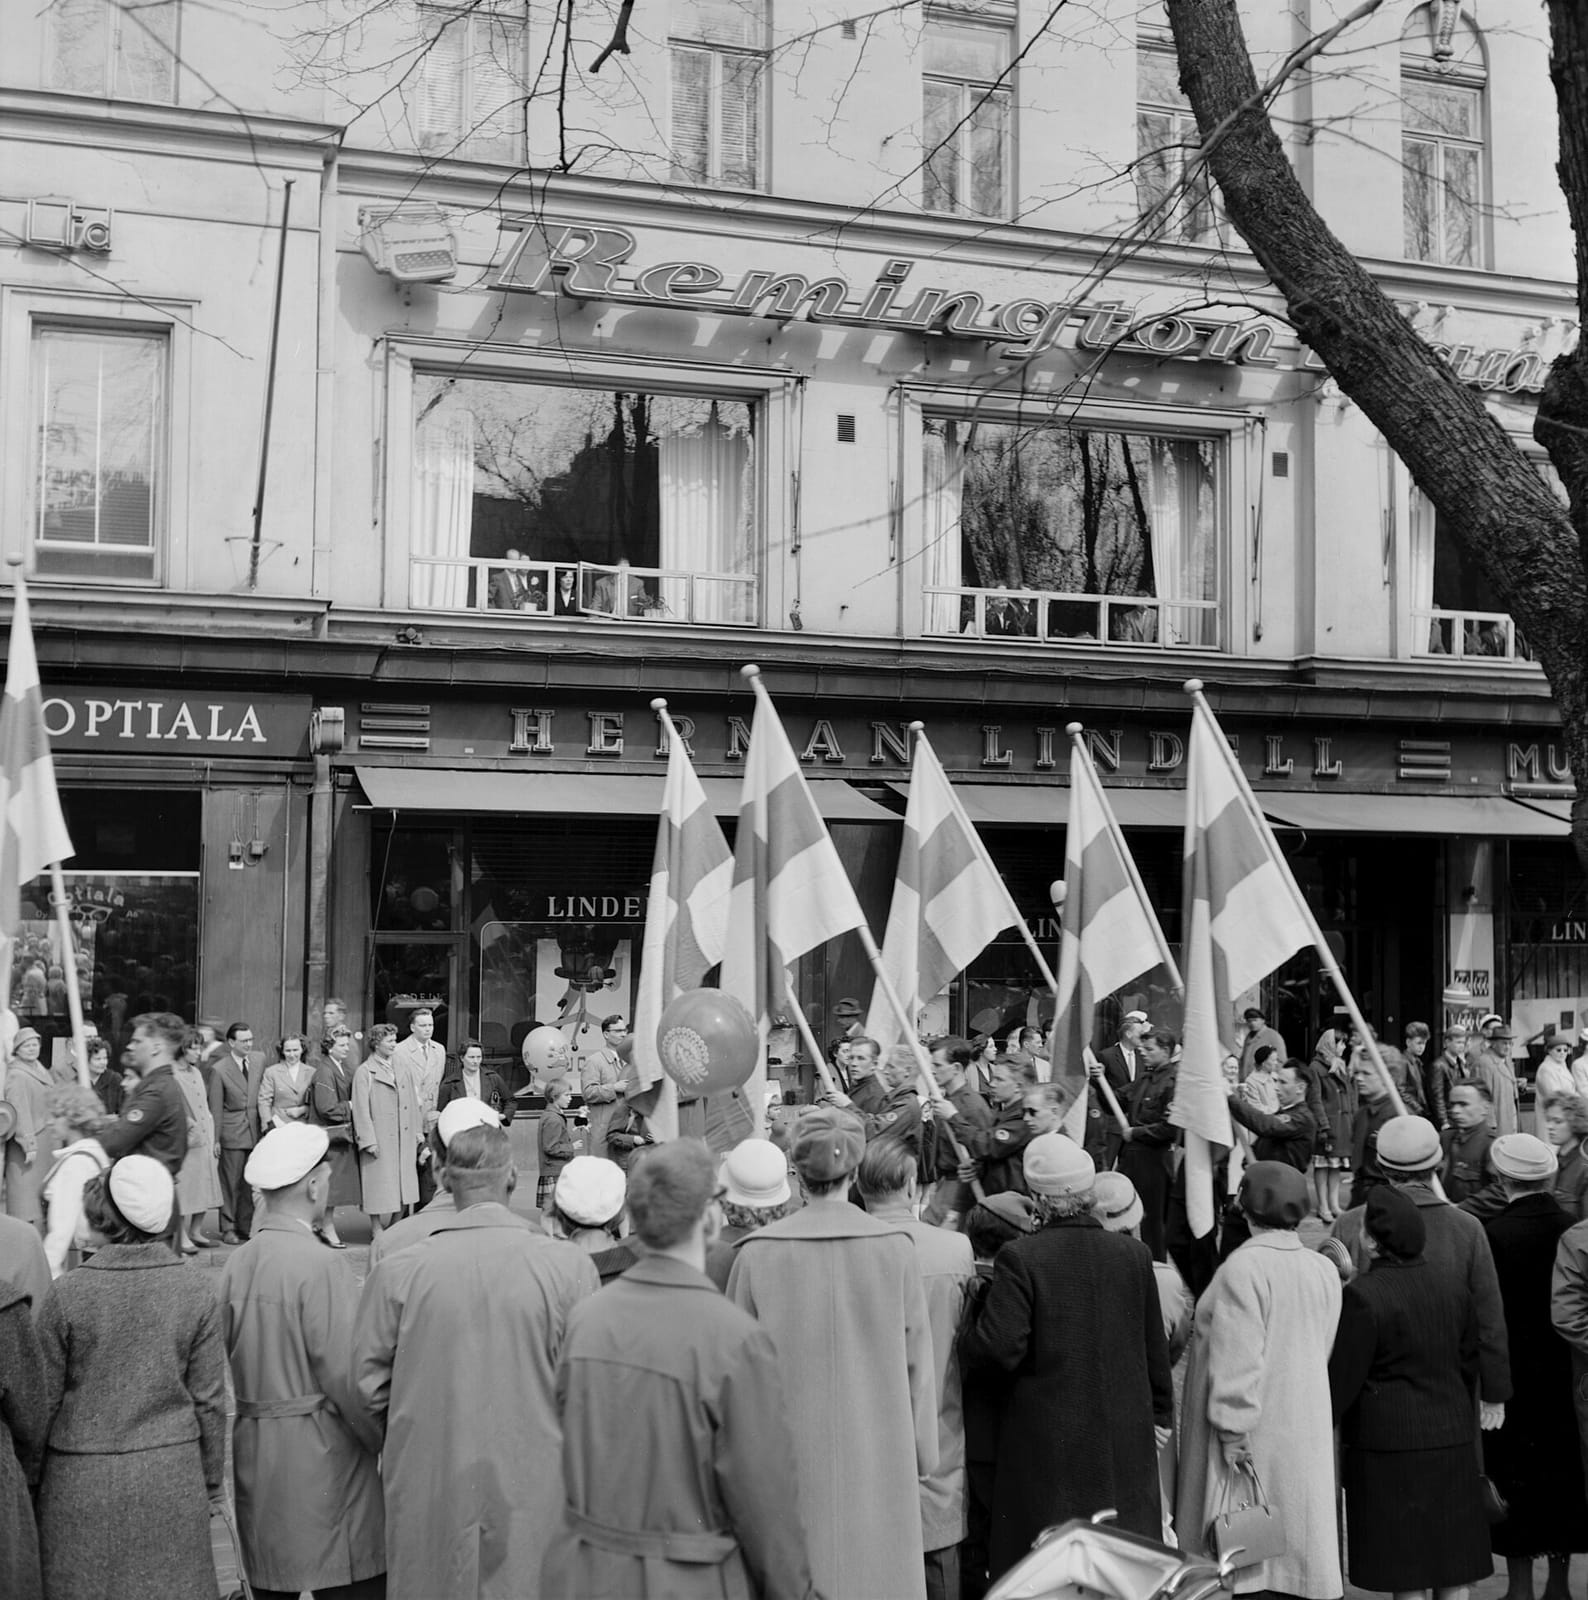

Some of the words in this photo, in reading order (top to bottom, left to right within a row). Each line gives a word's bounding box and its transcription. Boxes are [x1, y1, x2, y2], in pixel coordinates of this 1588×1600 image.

[496, 214, 1280, 366] Remington
[41, 698, 268, 743] OPTIALA
[981, 724, 1343, 777] LINDLL
[547, 896, 649, 918] LINDE
